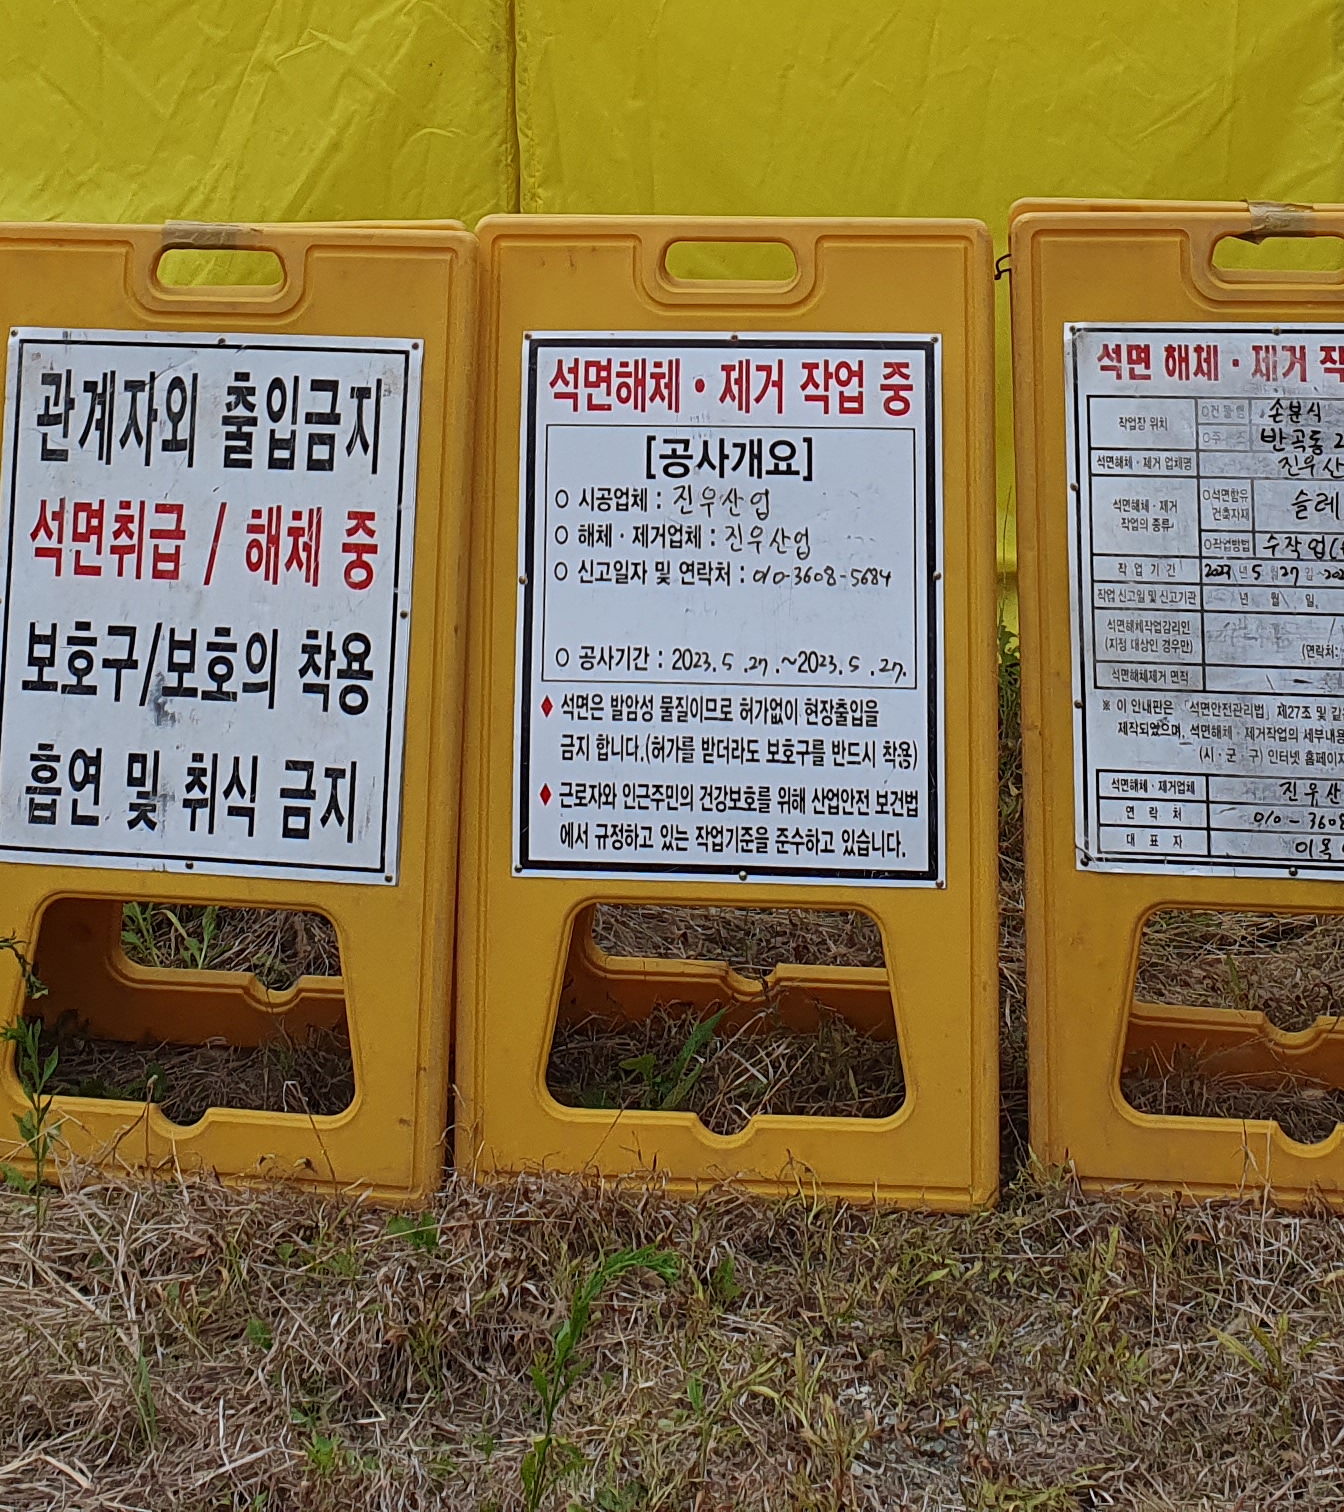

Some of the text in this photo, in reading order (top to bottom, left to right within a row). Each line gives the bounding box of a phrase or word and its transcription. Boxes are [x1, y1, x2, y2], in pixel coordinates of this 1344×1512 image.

[1096, 343, 1153, 382] 석면
[1162, 343, 1219, 383] 해체
[1250, 344, 1308, 384] 제거
[548, 357, 913, 416] 석면해체 제거 작업 중
[36, 366, 382, 474] 관계자외 출입금지
[645, 435, 812, 481] [공사개요]
[578, 486, 647, 512] 시공업체
[29, 496, 186, 580] 석면취급
[245, 504, 321, 587] 해체
[341, 510, 378, 590] 중
[577, 523, 612, 548] 해체
[631, 523, 701, 549] 제거업체
[577, 559, 647, 584] 신고일자
[654, 560, 670, 585] 및
[678, 560, 730, 586] 연락처
[297, 629, 373, 715] 착용
[578, 645, 649, 671] 공사기간
[560, 693, 878, 727] 석면은 발암성 물질이므로 허가없이 현장출입을
[560, 733, 589, 761] 금지
[701, 736, 760, 765] 받더라도
[765, 738, 825, 766] 보호구를
[831, 739, 875, 768] 반드시
[882, 740, 917, 770] 착용)
[24, 742, 356, 843] 흡연 및 취식 금지
[558, 781, 918, 817] 근로자와 인근주민의 건강보호를 위해 산업안전 보건법
[559, 821, 905, 858] 에서 규정하고 있는 작업기준을 준수하고 있습니다.
